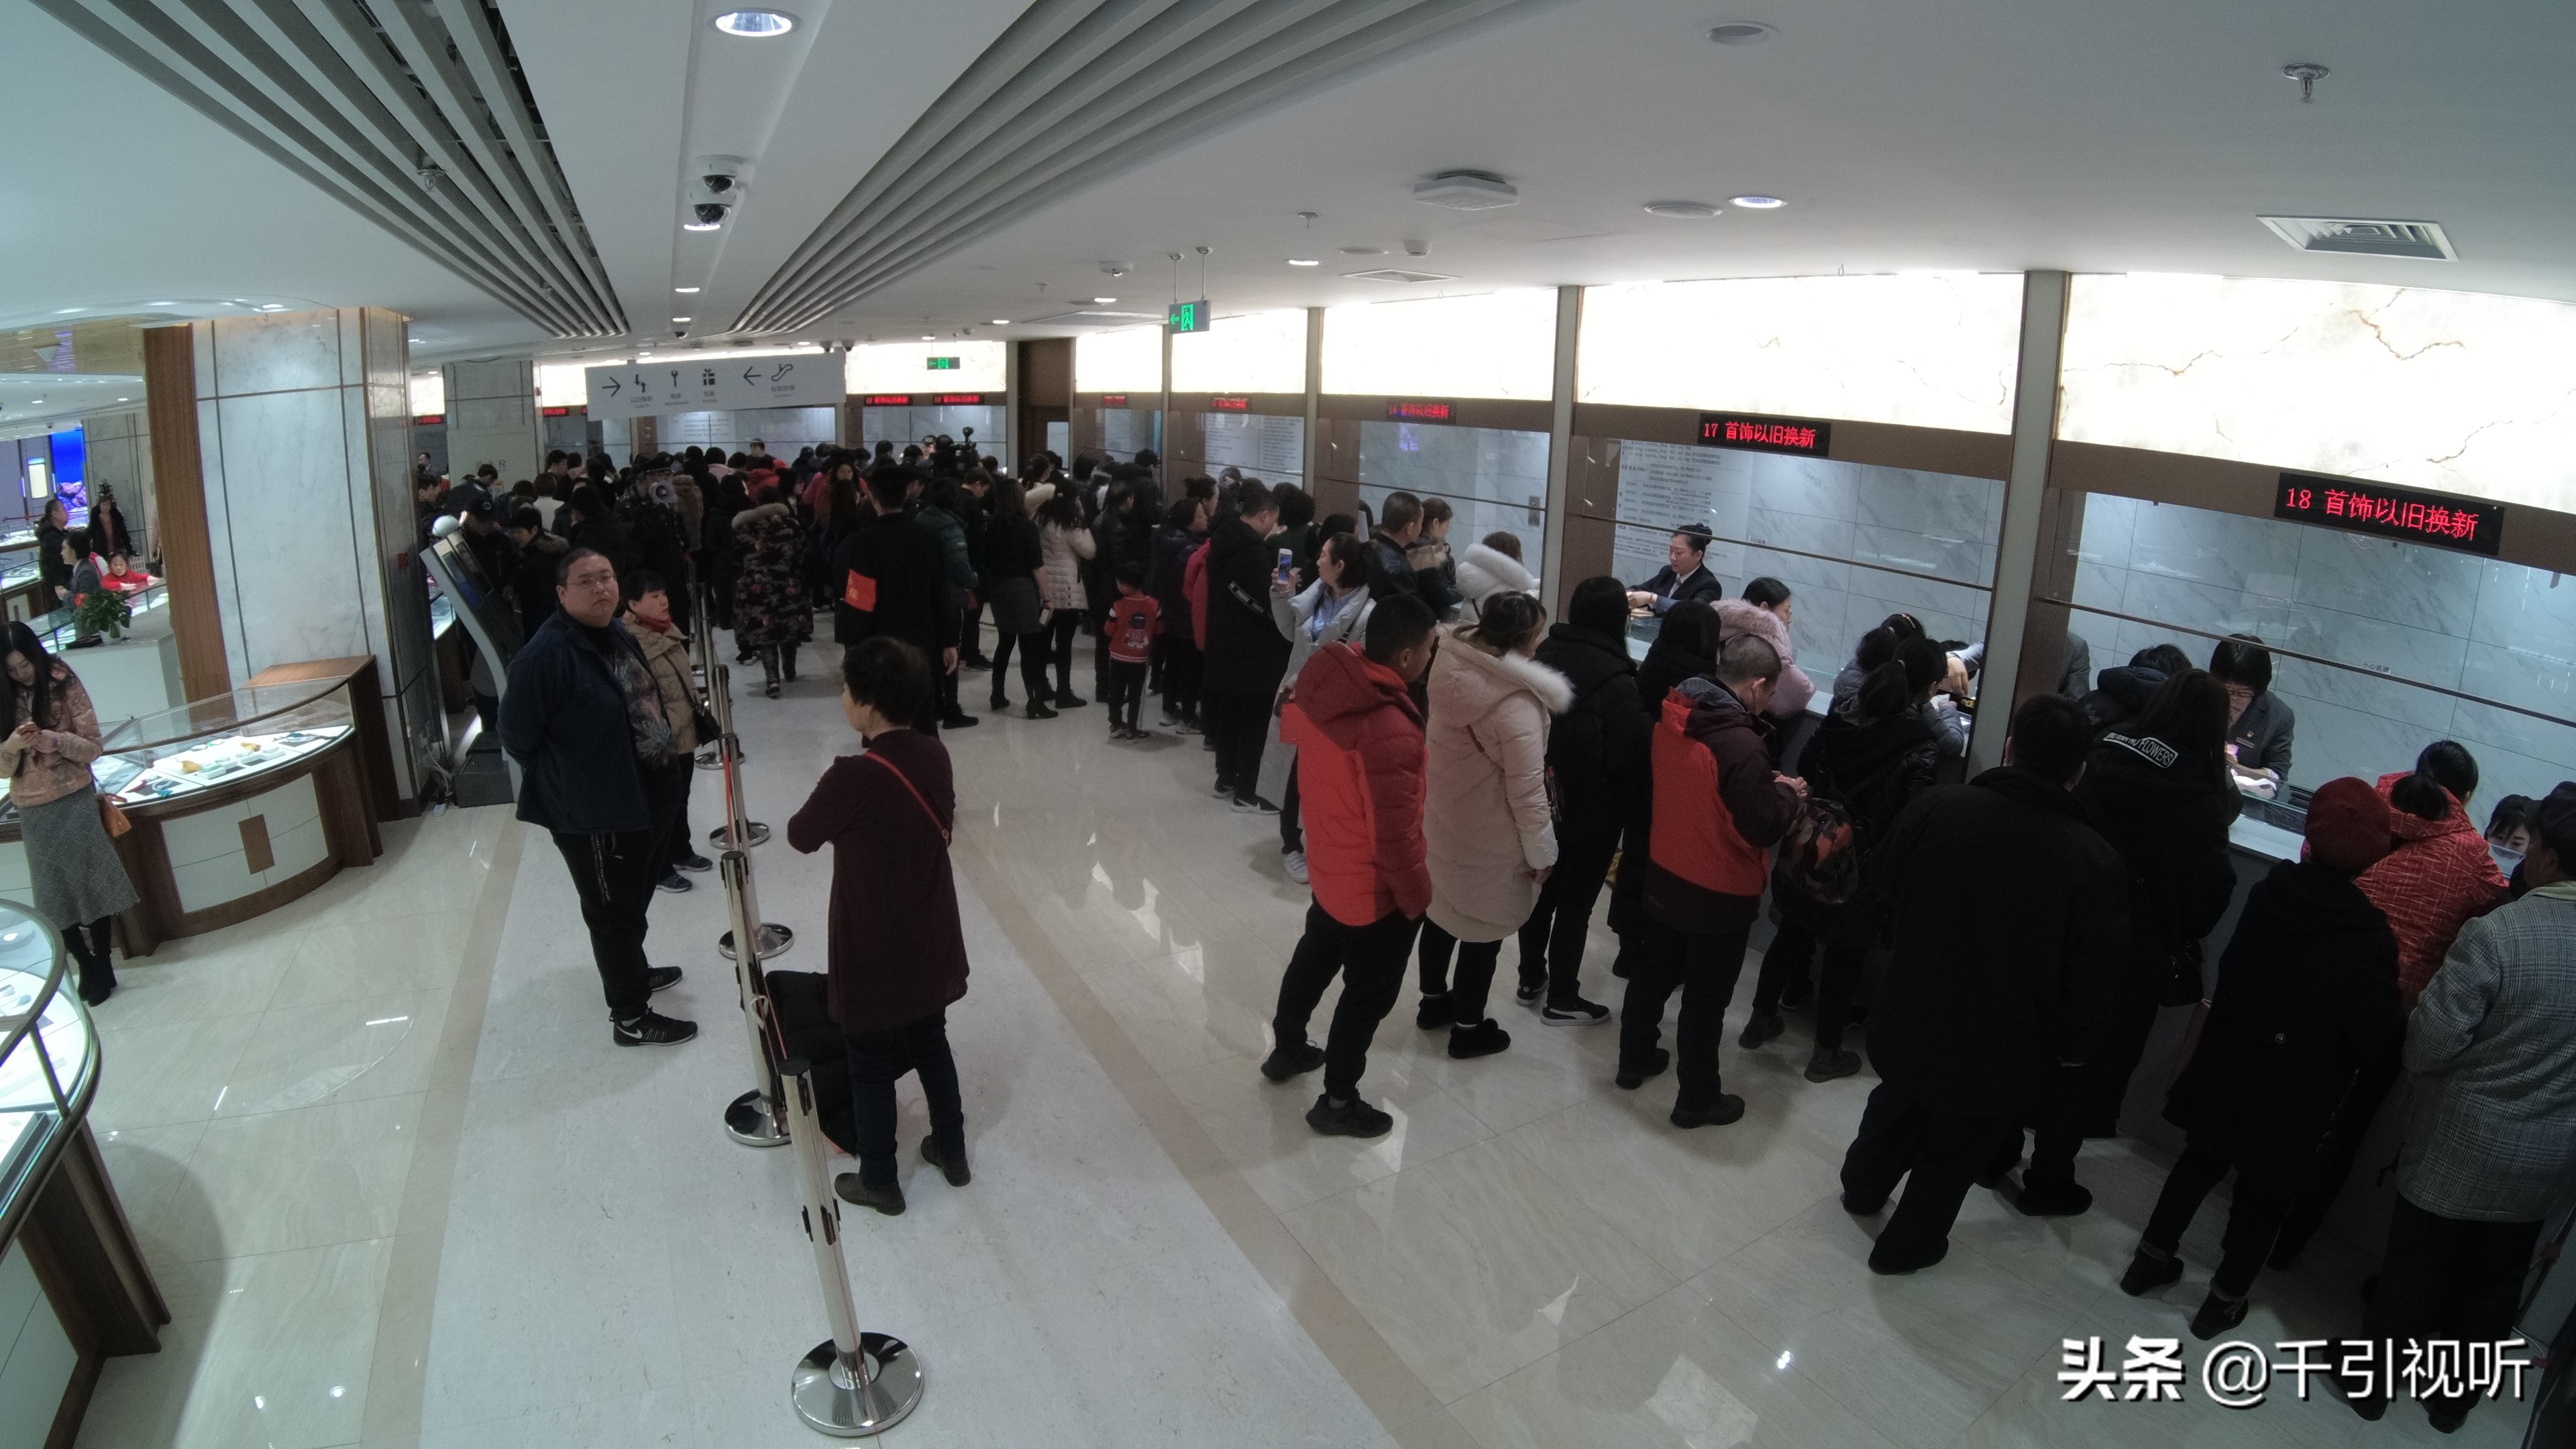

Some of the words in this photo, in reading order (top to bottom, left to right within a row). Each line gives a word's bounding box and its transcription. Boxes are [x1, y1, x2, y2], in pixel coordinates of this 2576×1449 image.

[1704, 423, 1719, 438] 17
[1725, 421, 1817, 449] 首饰以旧换新
[2286, 488, 2312, 510] 18
[2324, 489, 2479, 541] 首饰以旧换新
[2138, 739, 2174, 765] FLOWERS
